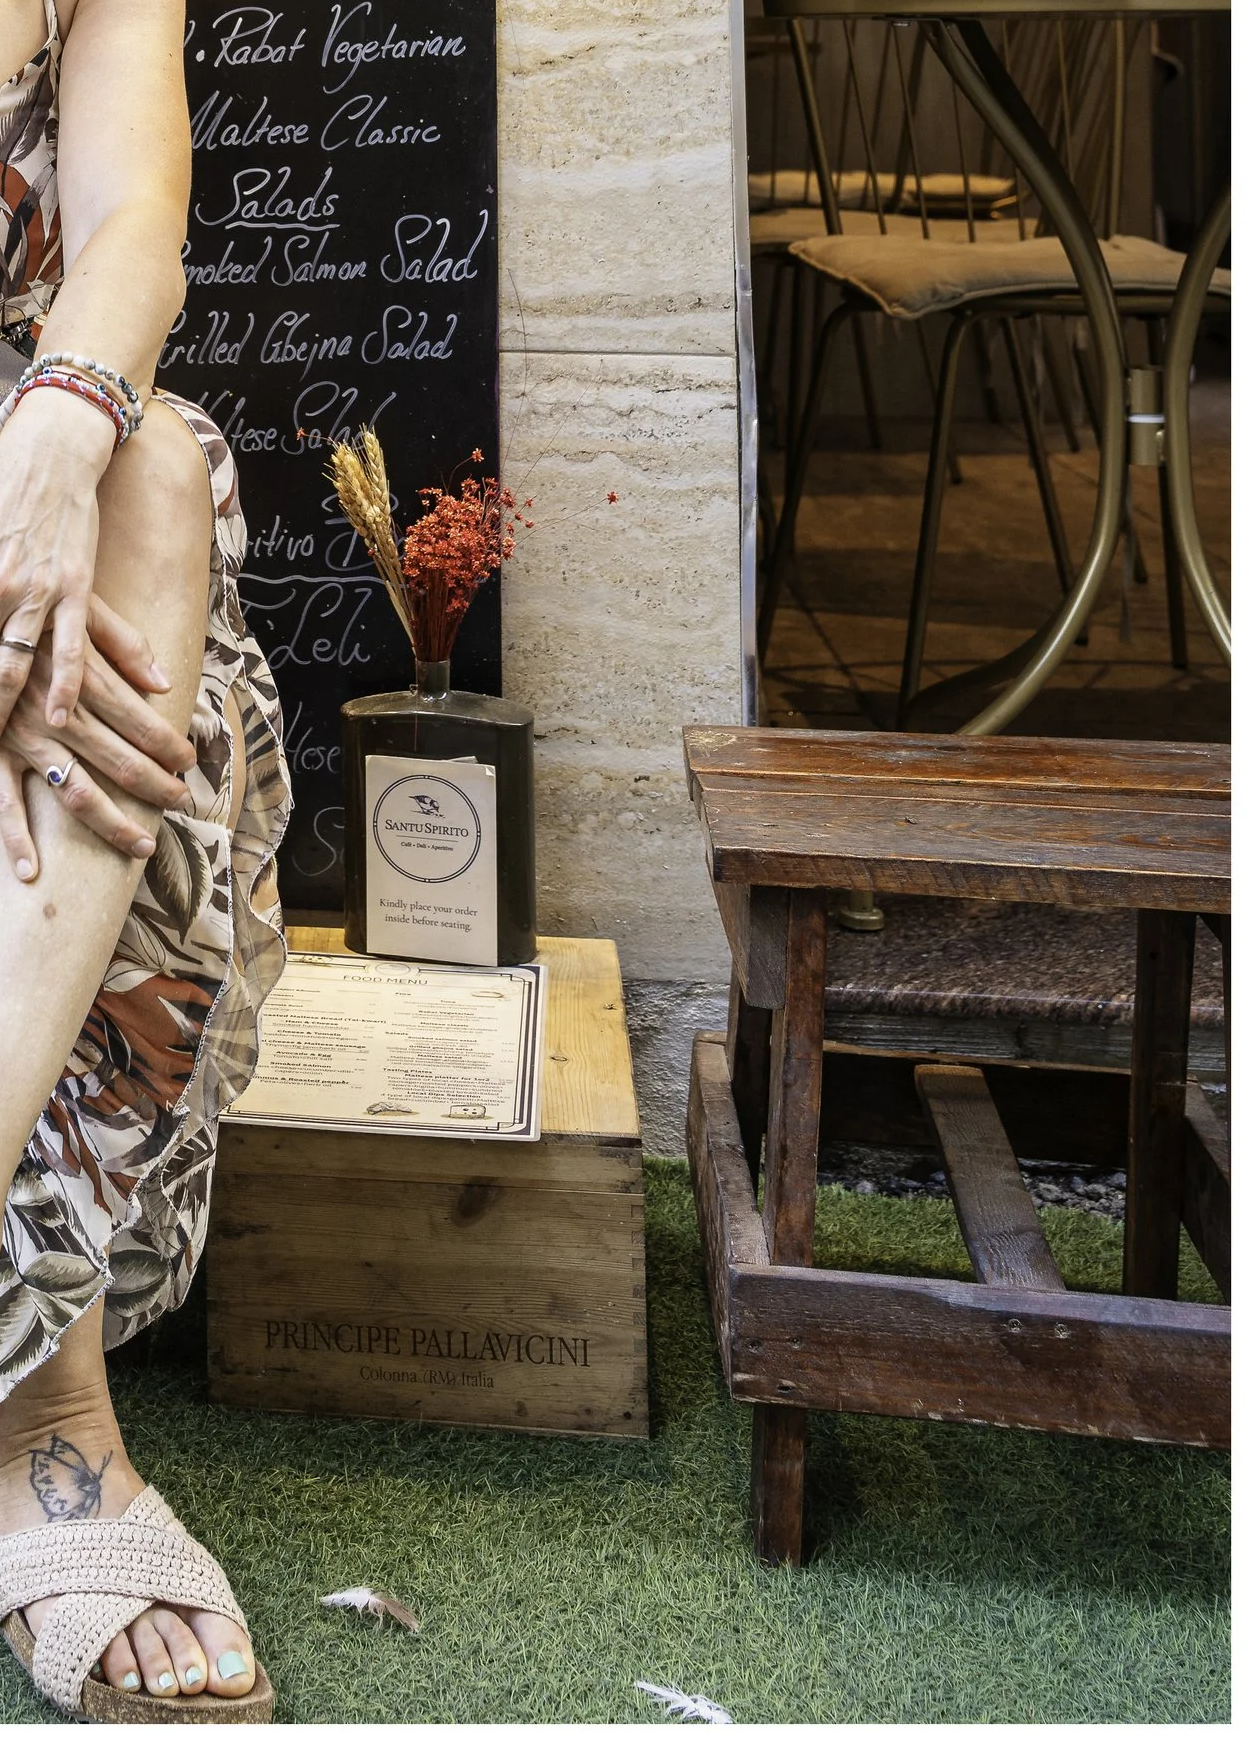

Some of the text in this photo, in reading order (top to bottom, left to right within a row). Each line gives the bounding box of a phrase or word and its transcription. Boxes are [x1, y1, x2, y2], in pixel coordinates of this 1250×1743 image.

[212, 1, 467, 94] Rabat Vegetarian
[189, 90, 441, 150] Maltese Classic
[195, 166, 340, 226] Salads
[271, 231, 367, 286] Salmon
[380, 209, 489, 284] Salad
[361, 305, 458, 364] Salad
[431, 844, 454, 852] Aperitivo
[379, 898, 478, 916] Kindly place your order
[385, 914, 472, 933] inside before seating.
[387, 977, 428, 985] MENU
[265, 1320, 592, 1367] PRINCIPE PALLAVICINI
[359, 1365, 495, 1389] Colonna (RM) Italia
